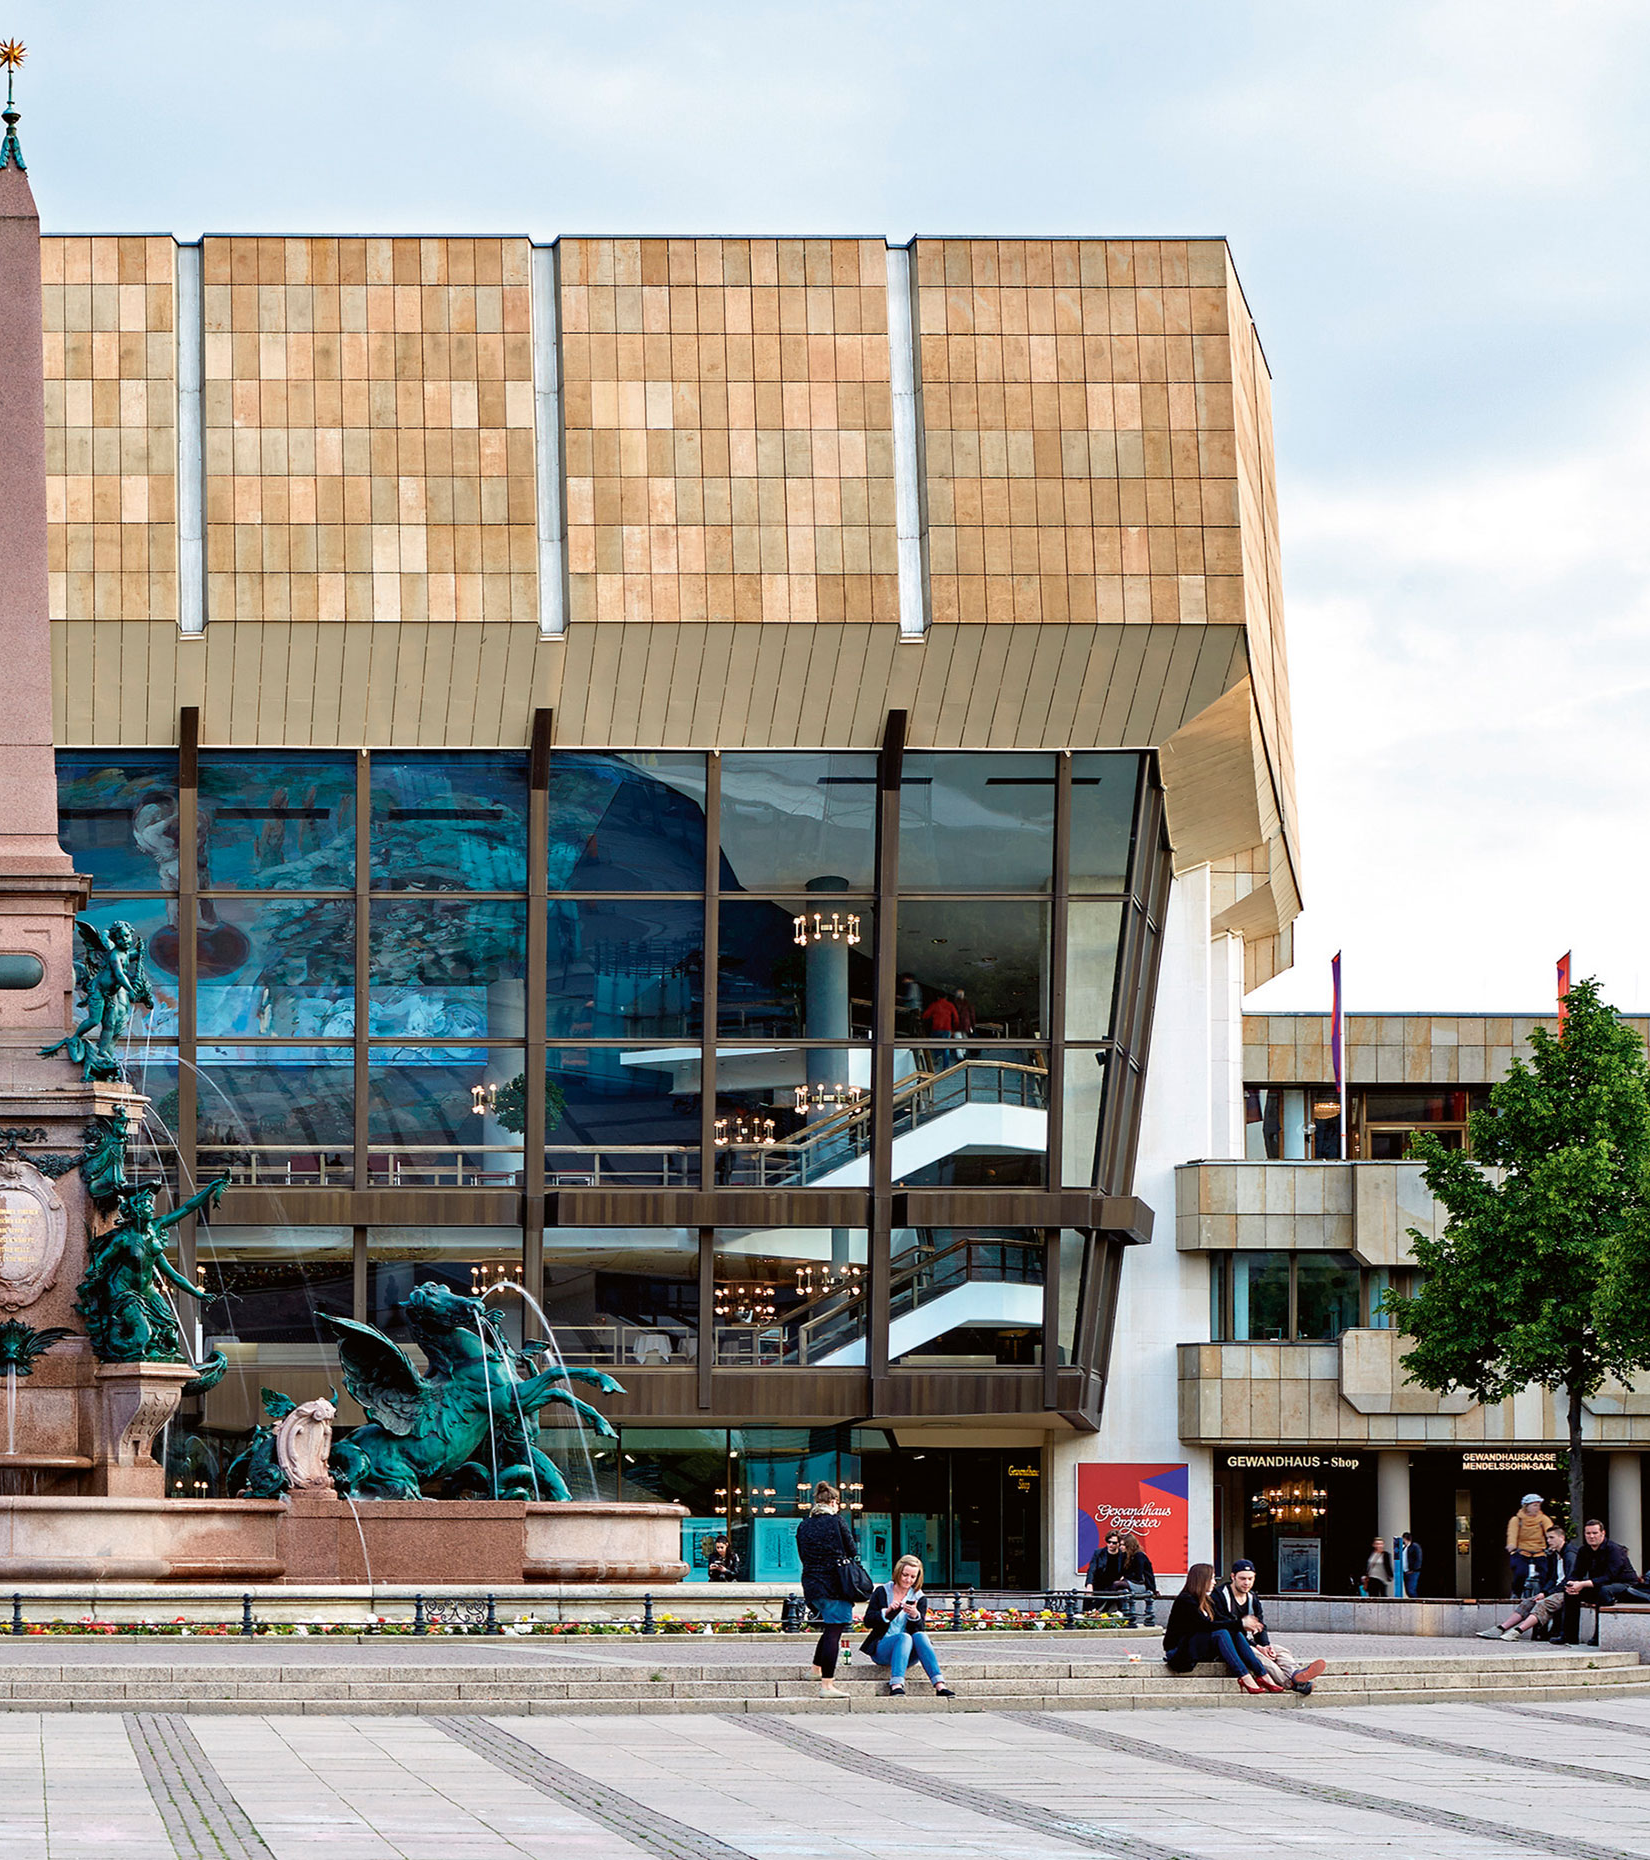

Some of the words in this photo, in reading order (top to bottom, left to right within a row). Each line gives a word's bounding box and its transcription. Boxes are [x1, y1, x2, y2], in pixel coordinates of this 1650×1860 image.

[1227, 1456, 1320, 1467] GEWANDHAUS
[1331, 1457, 1359, 1469] Shop
[1462, 1453, 1557, 1461] GEWANDHAUSKASSE
[1462, 1462, 1557, 1470] MENDELSSOHN-SAAL
[1094, 1501, 1171, 1522] Gewandhaus
[1110, 1515, 1161, 1536] Orchester
